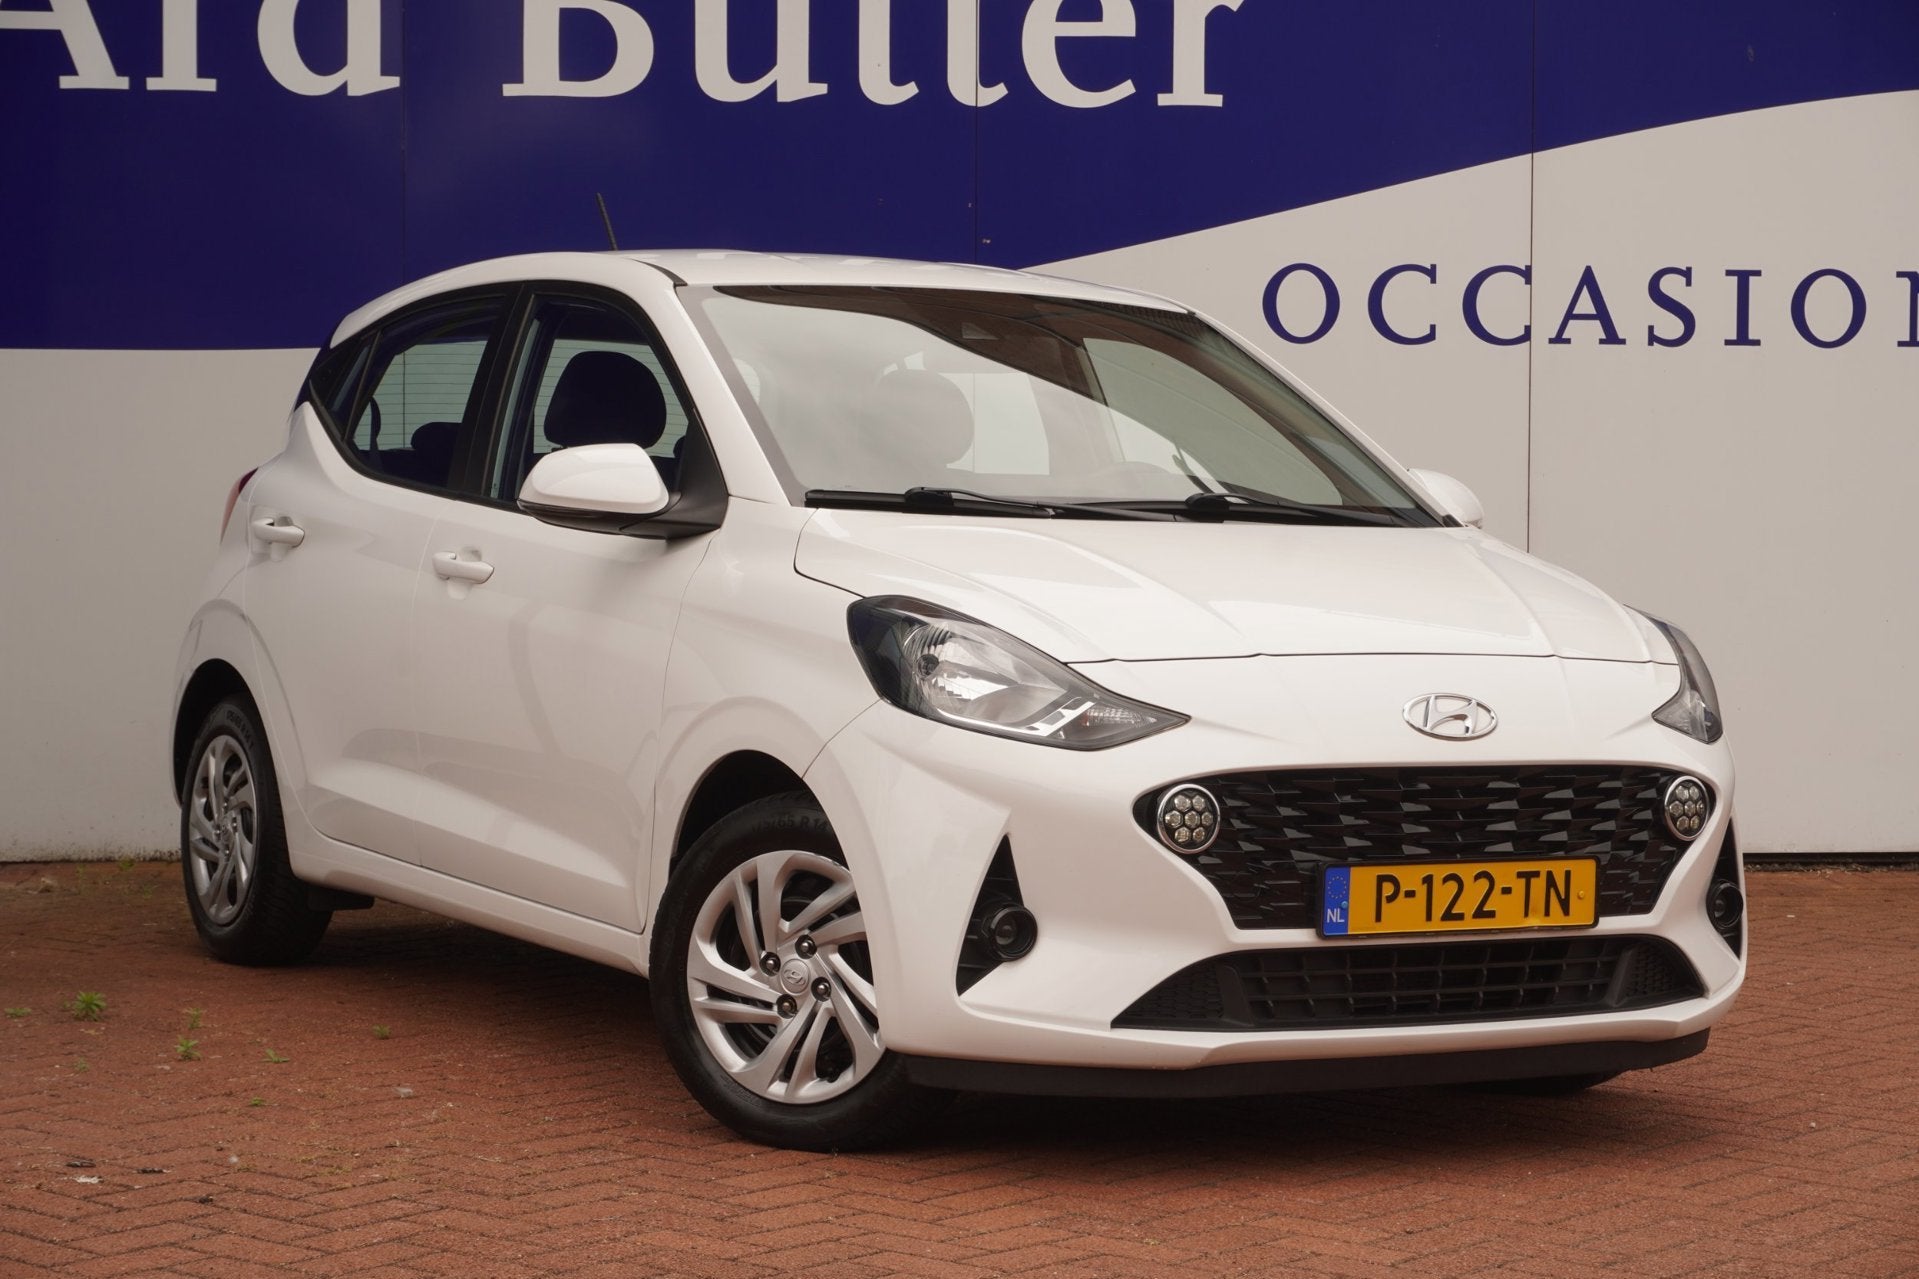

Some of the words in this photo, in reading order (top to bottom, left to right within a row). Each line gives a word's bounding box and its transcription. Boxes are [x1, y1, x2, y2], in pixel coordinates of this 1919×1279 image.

[1262, 262, 1919, 349] OCCASIO
[1326, 908, 1345, 923] NL
[1375, 869, 1572, 923] P-122-TN
